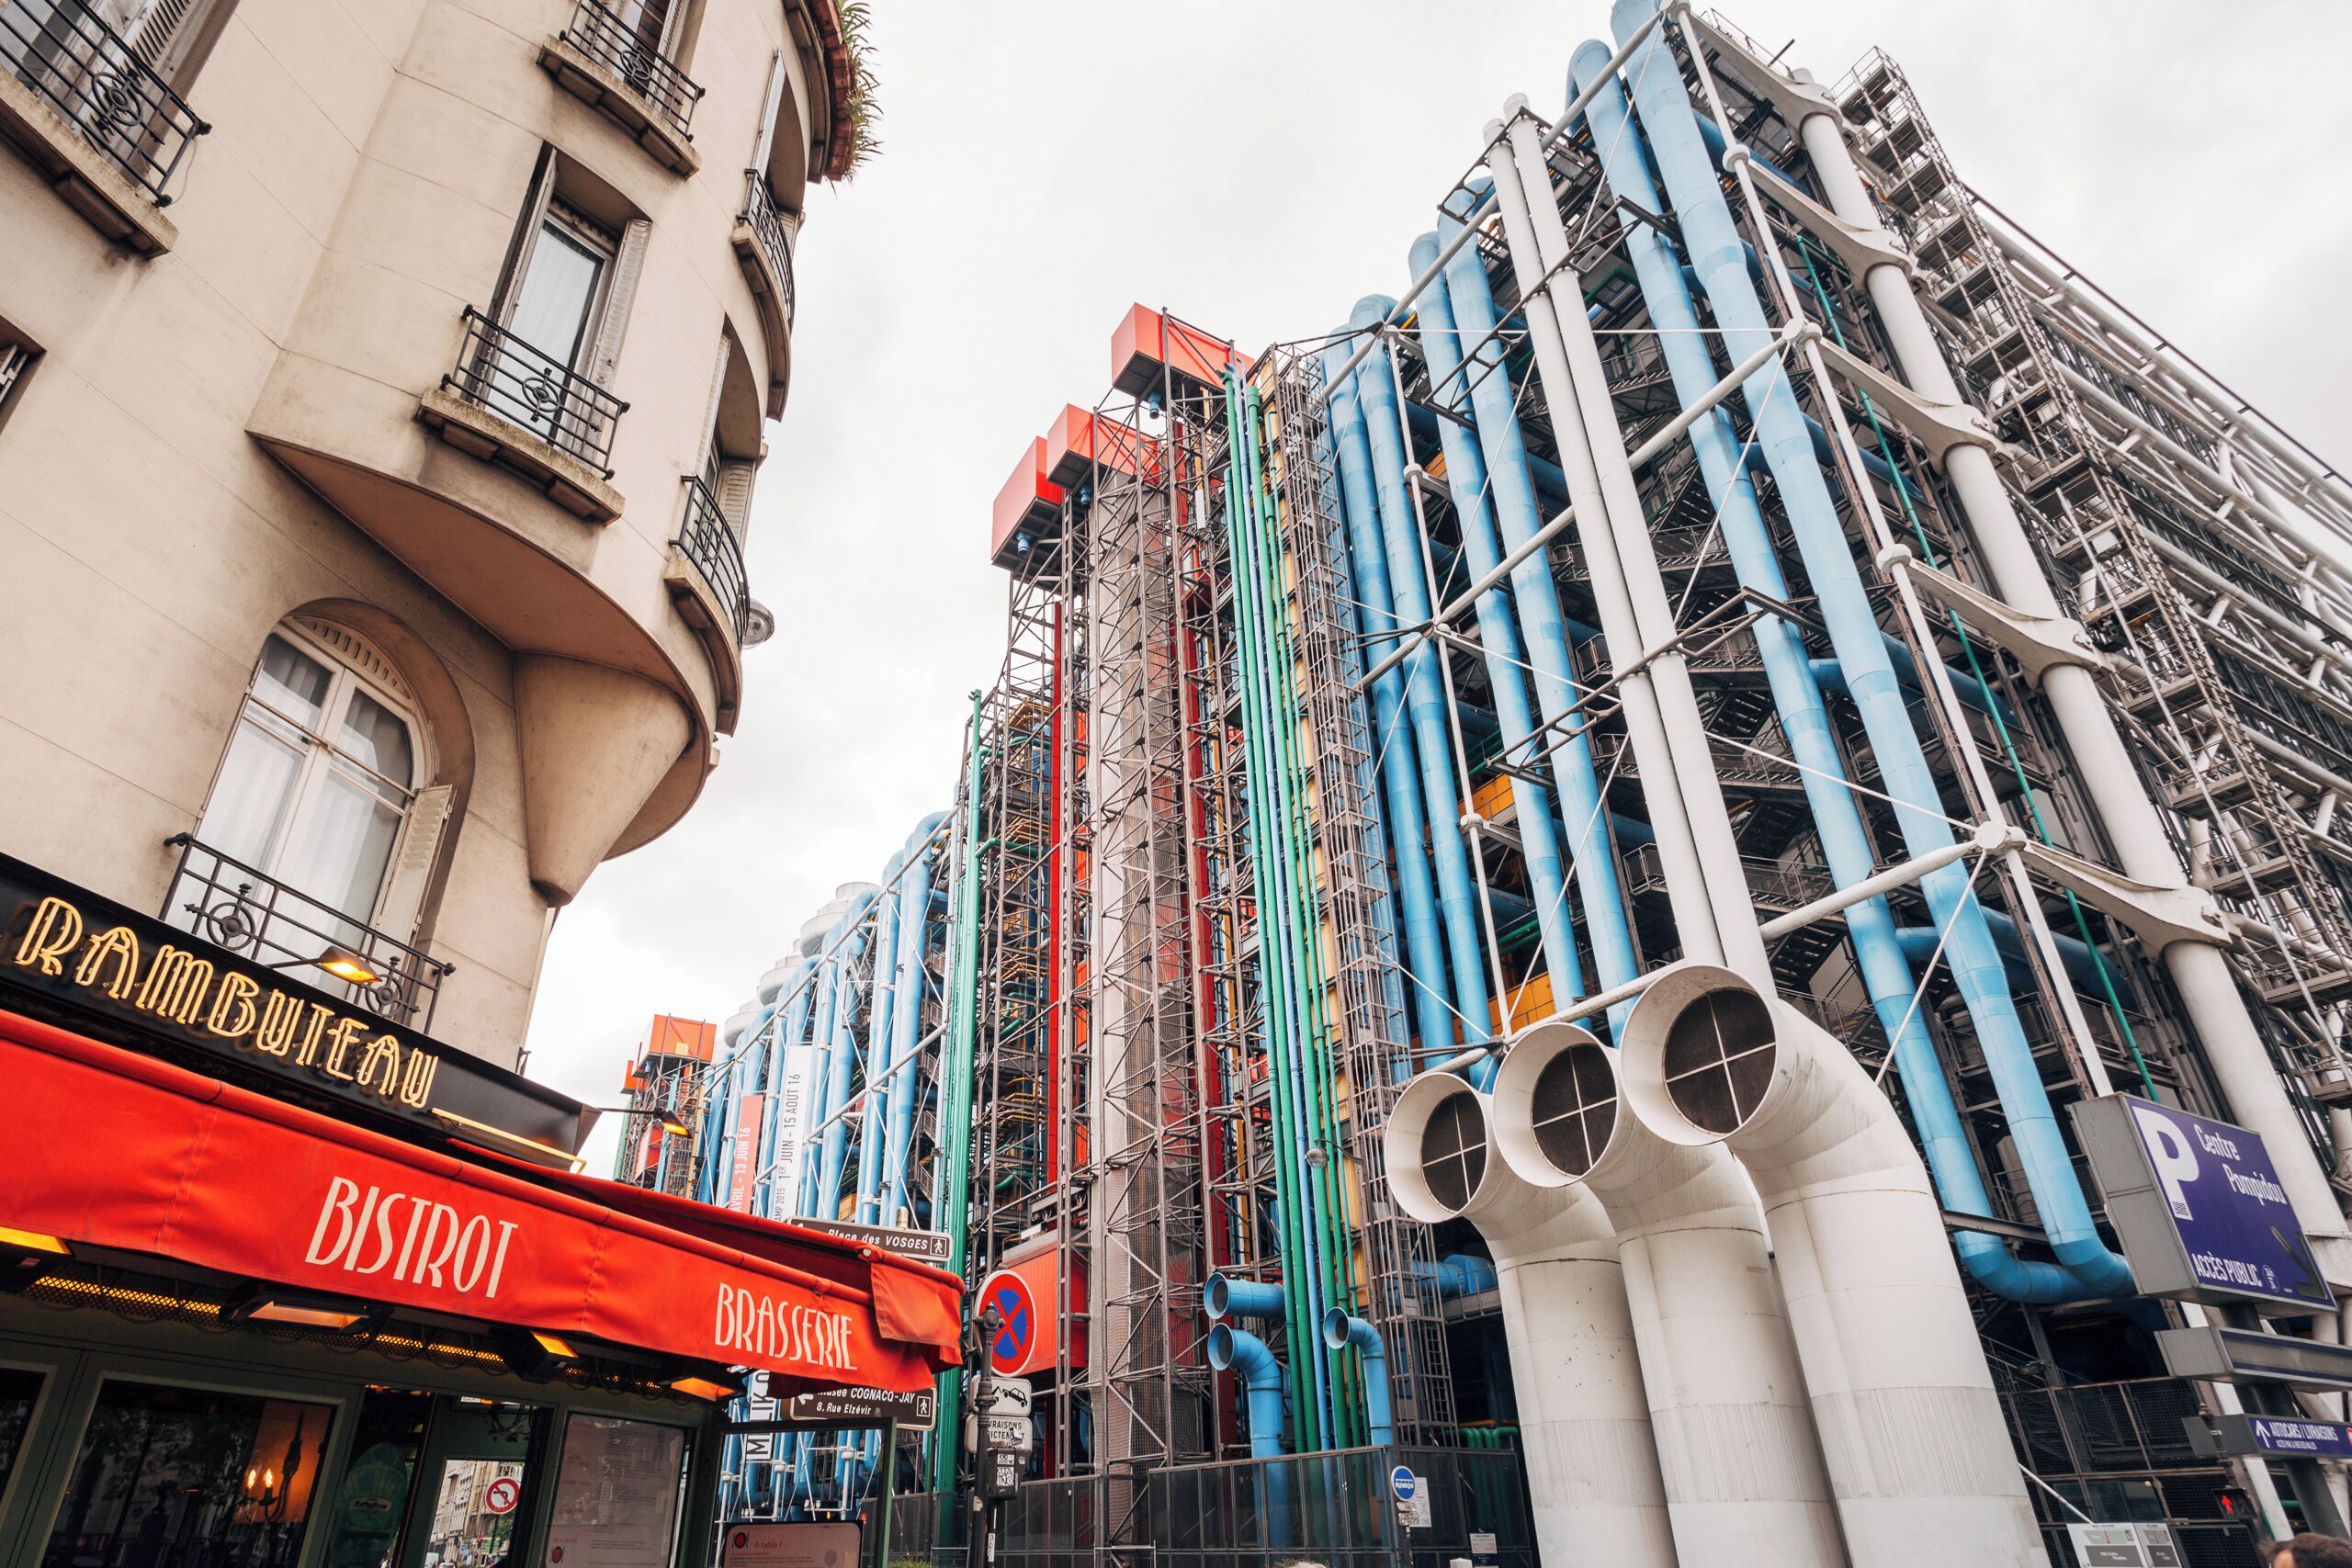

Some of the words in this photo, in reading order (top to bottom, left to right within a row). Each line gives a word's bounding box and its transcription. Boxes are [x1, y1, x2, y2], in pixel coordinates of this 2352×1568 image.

[14, 897, 439, 1109] RAMBUTEAU
[788, 1074, 800, 1086] 16
[785, 1089, 799, 1114] AOUT
[740, 1126, 751, 1139] 16
[784, 1116, 797, 1128] 15
[736, 1141, 749, 1162] JUIN
[780, 1140, 794, 1163] JUIN
[2194, 1123, 2241, 1161] Centre
[735, 1163, 747, 1175] 13
[2132, 1106, 2199, 1221] P
[776, 1187, 786, 1202] 2015
[2222, 1163, 2288, 1206] Pompidou
[729, 1185, 745, 1213] AVRIL
[775, 1202, 783, 1222] AMP
[305, 1176, 518, 1299] BISTROT
[828, 1228, 857, 1242] Place
[862, 1234, 880, 1245] des
[886, 1235, 928, 1250] VOSGES
[2191, 1250, 2228, 1280] ACCÈS
[2223, 1258, 2263, 1288] PUBLIC
[715, 1282, 858, 1371] BRASSERIE
[850, 1387, 915, 1404] COGNACQ-JAY
[817, 1402, 824, 1412] 8,
[826, 1403, 842, 1413] Rue
[843, 1404, 872, 1415] Elzévir
[989, 1420, 1022, 1429] VRAISONS
[2302, 1424, 2338, 1441] LIVRAISONS
[761, 1540, 778, 1549] table
